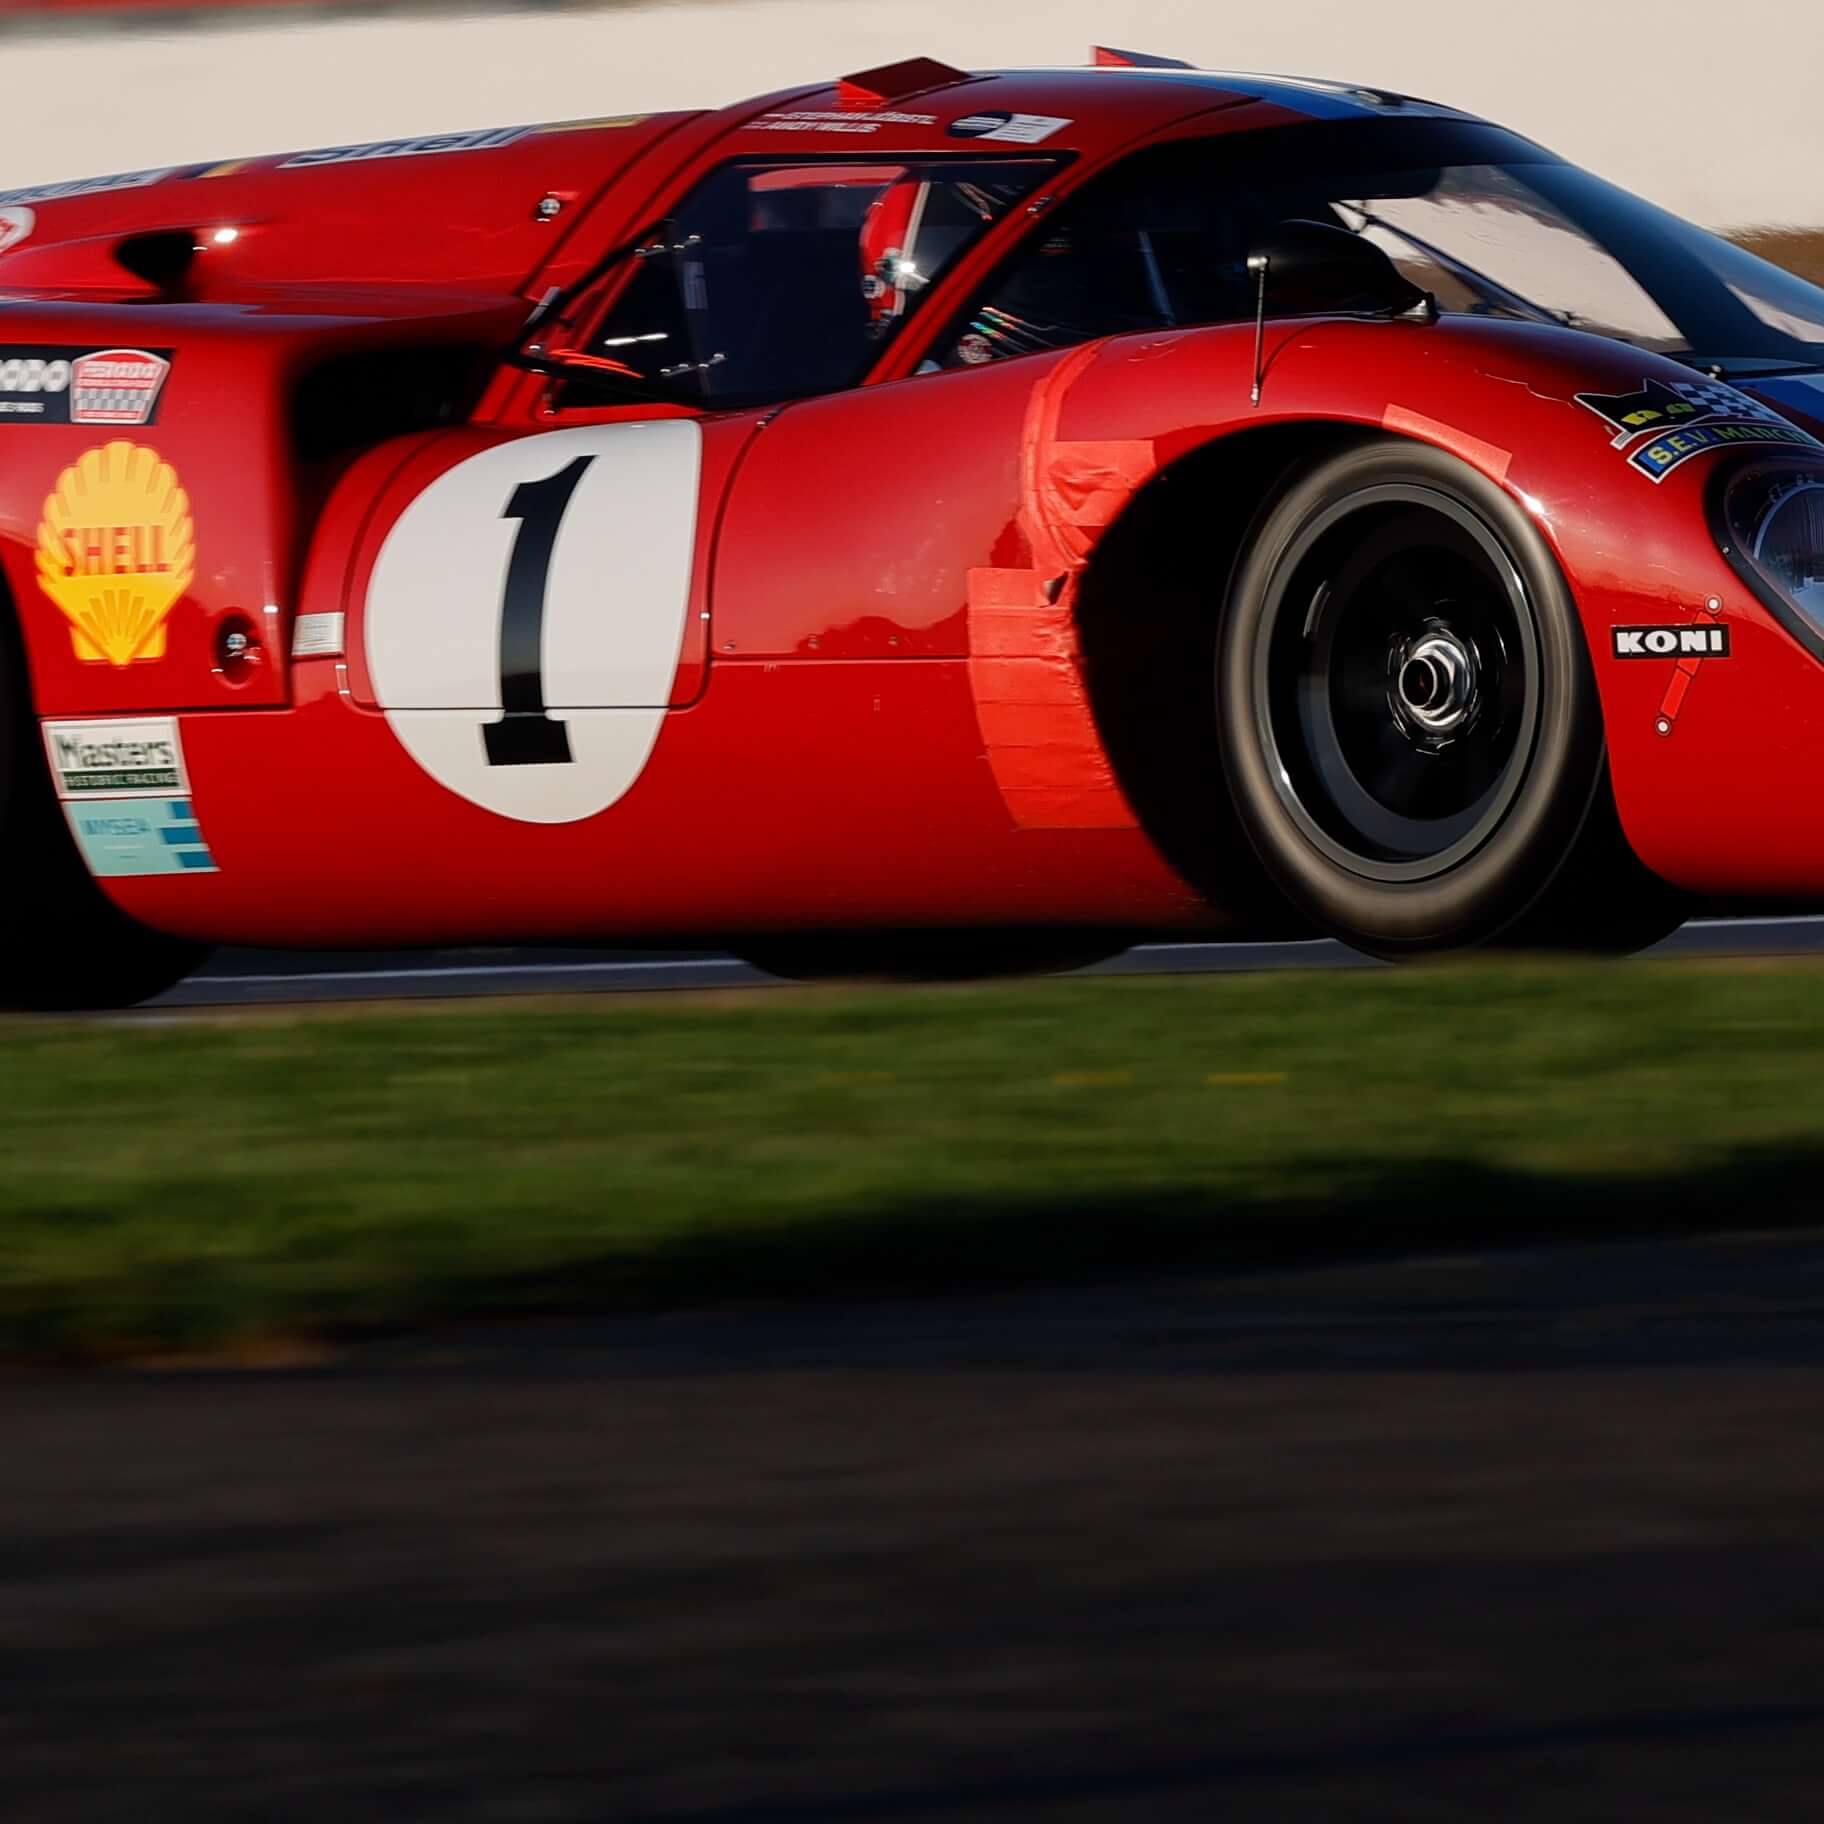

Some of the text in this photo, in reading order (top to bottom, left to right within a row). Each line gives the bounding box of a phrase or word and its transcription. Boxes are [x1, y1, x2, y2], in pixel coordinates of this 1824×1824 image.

[62, 525, 172, 577] SHELL
[480, 455, 598, 766] 1
[1616, 630, 1723, 653] KONI
[54, 734, 175, 768] Masters
